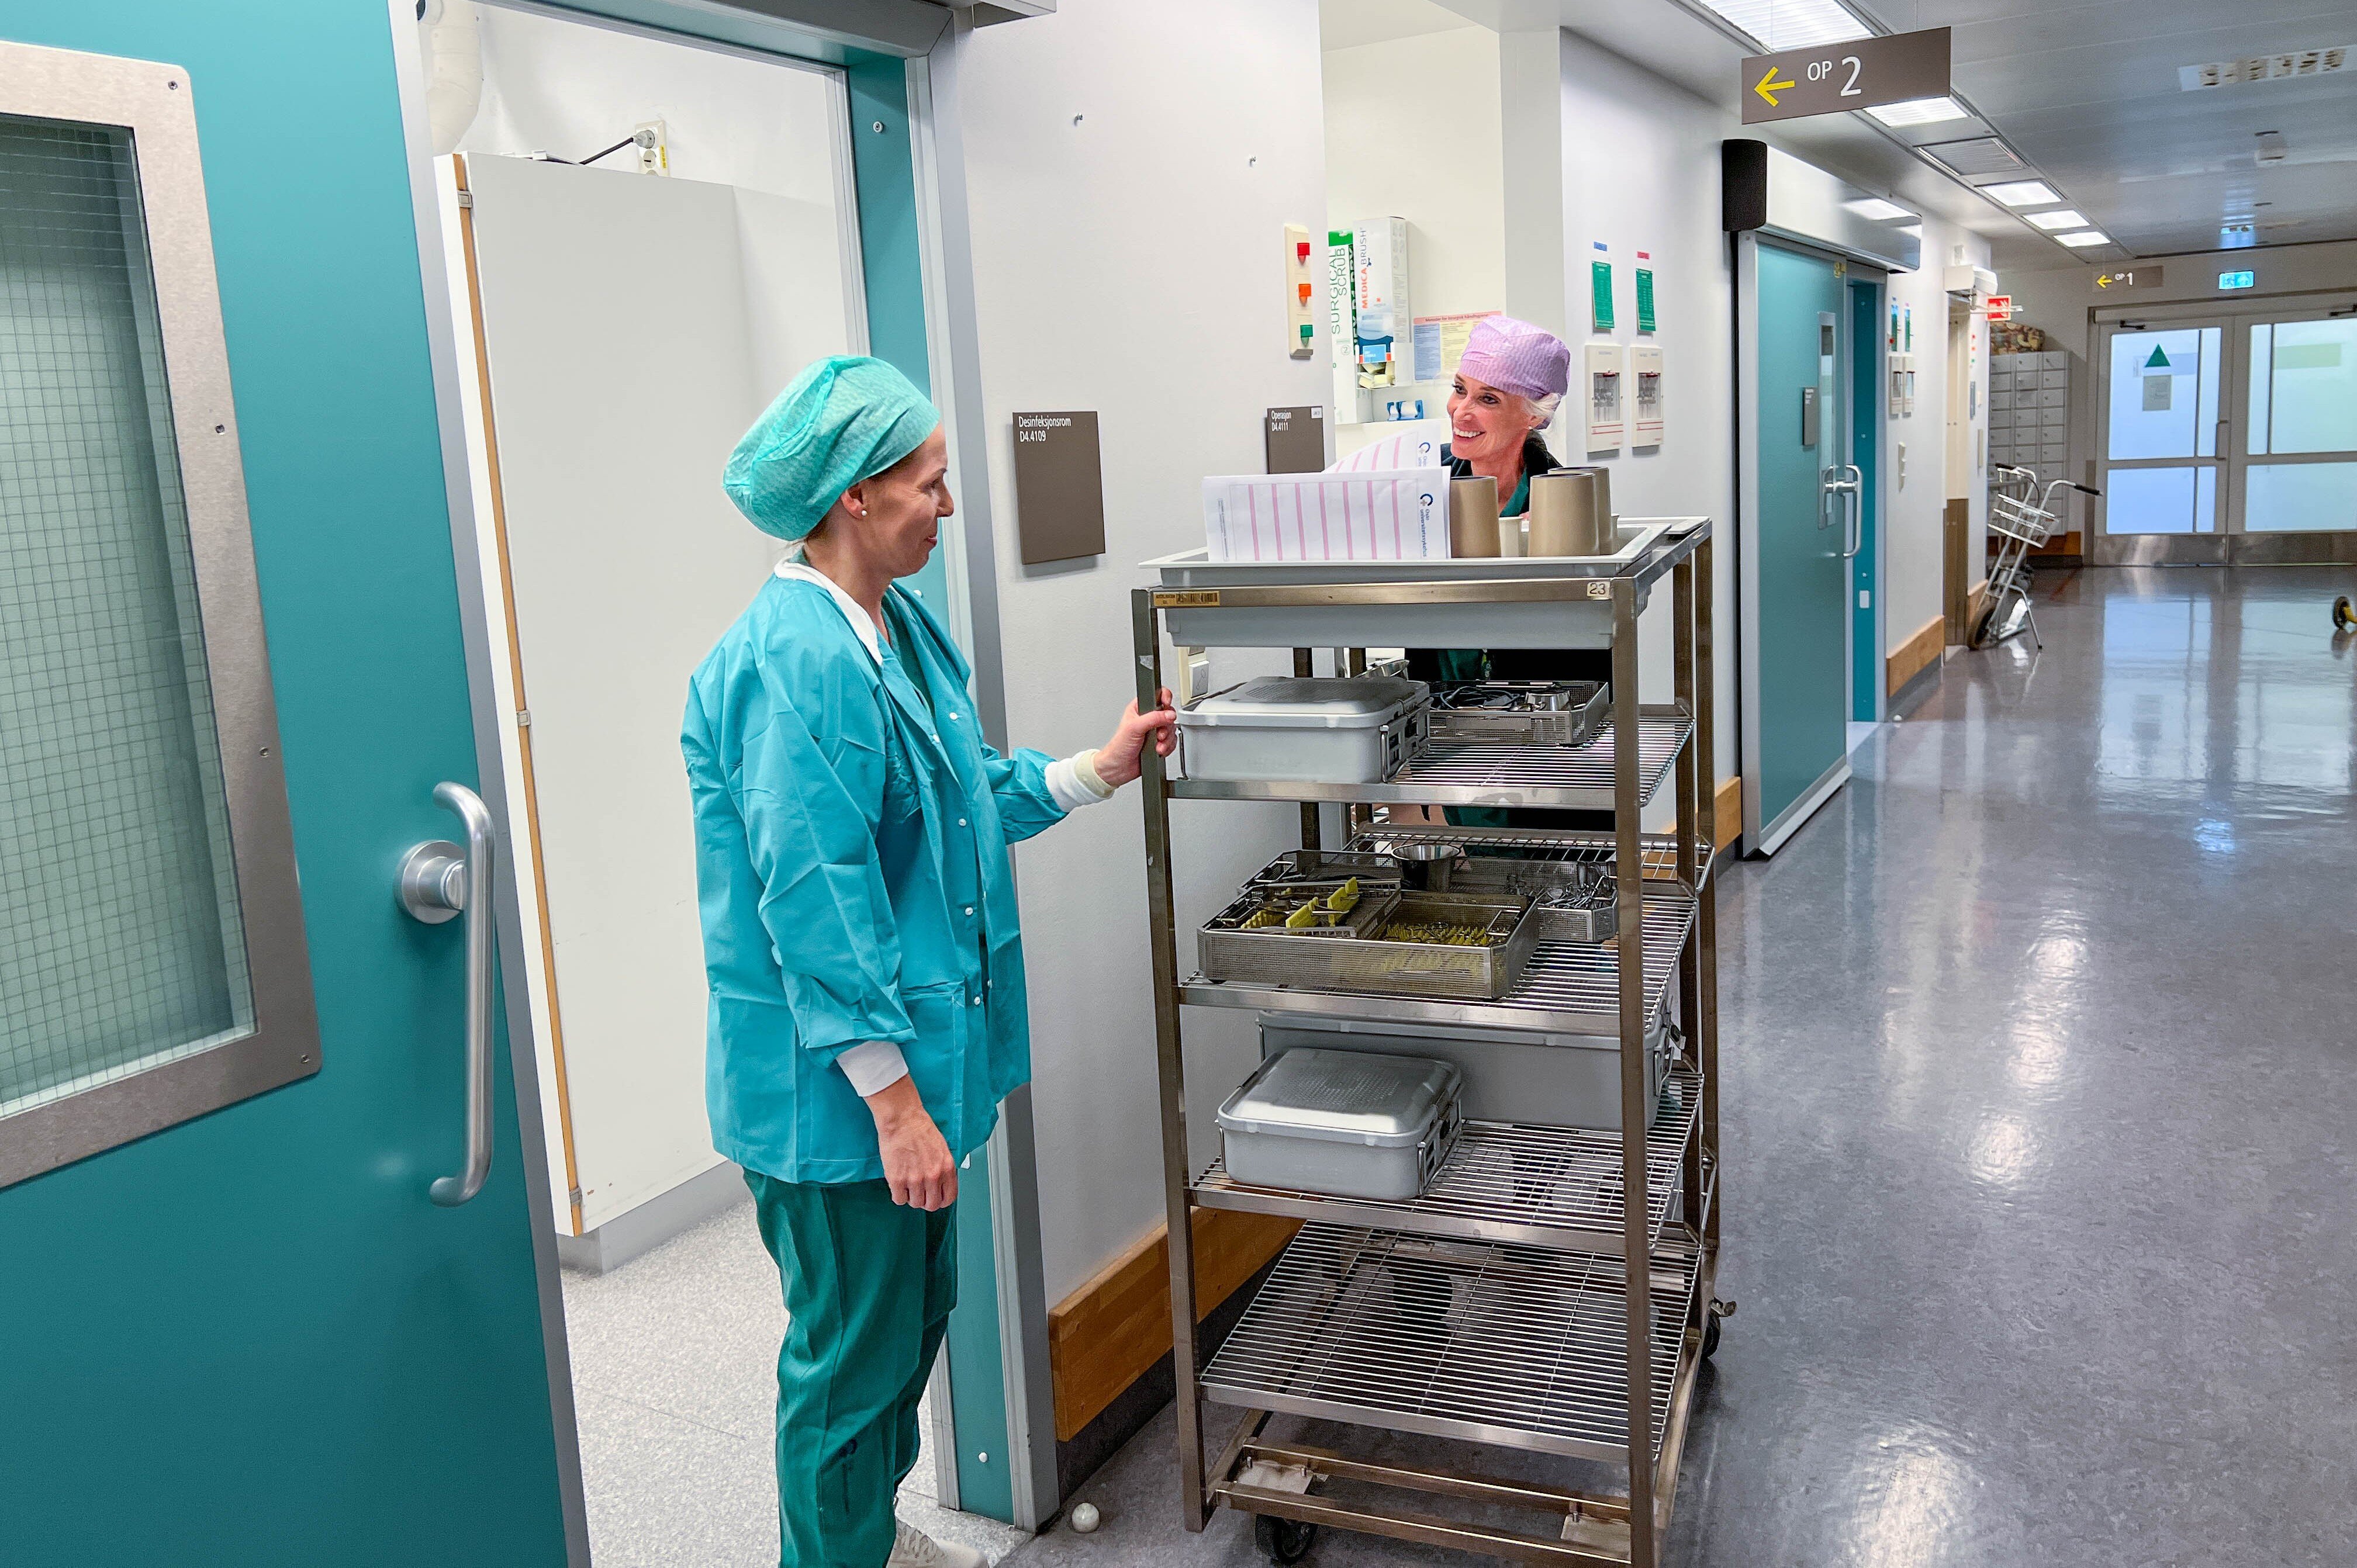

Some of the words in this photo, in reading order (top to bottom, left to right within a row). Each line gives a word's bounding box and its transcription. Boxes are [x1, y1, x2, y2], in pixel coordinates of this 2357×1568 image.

[1807, 60, 1833, 81] OP
[1840, 56, 1862, 96] 2
[1336, 248, 1347, 296] SCRUB
[2127, 272, 2133, 286] 1
[1329, 248, 1340, 334] SURGICAL
[1018, 415, 1072, 430] Desinfeksjonsrom
[1271, 410, 1292, 422] Operasjon
[1271, 421, 1289, 432] D4.4111
[1019, 430, 1046, 442] D4.4109
[1590, 583, 1606, 595] 23
